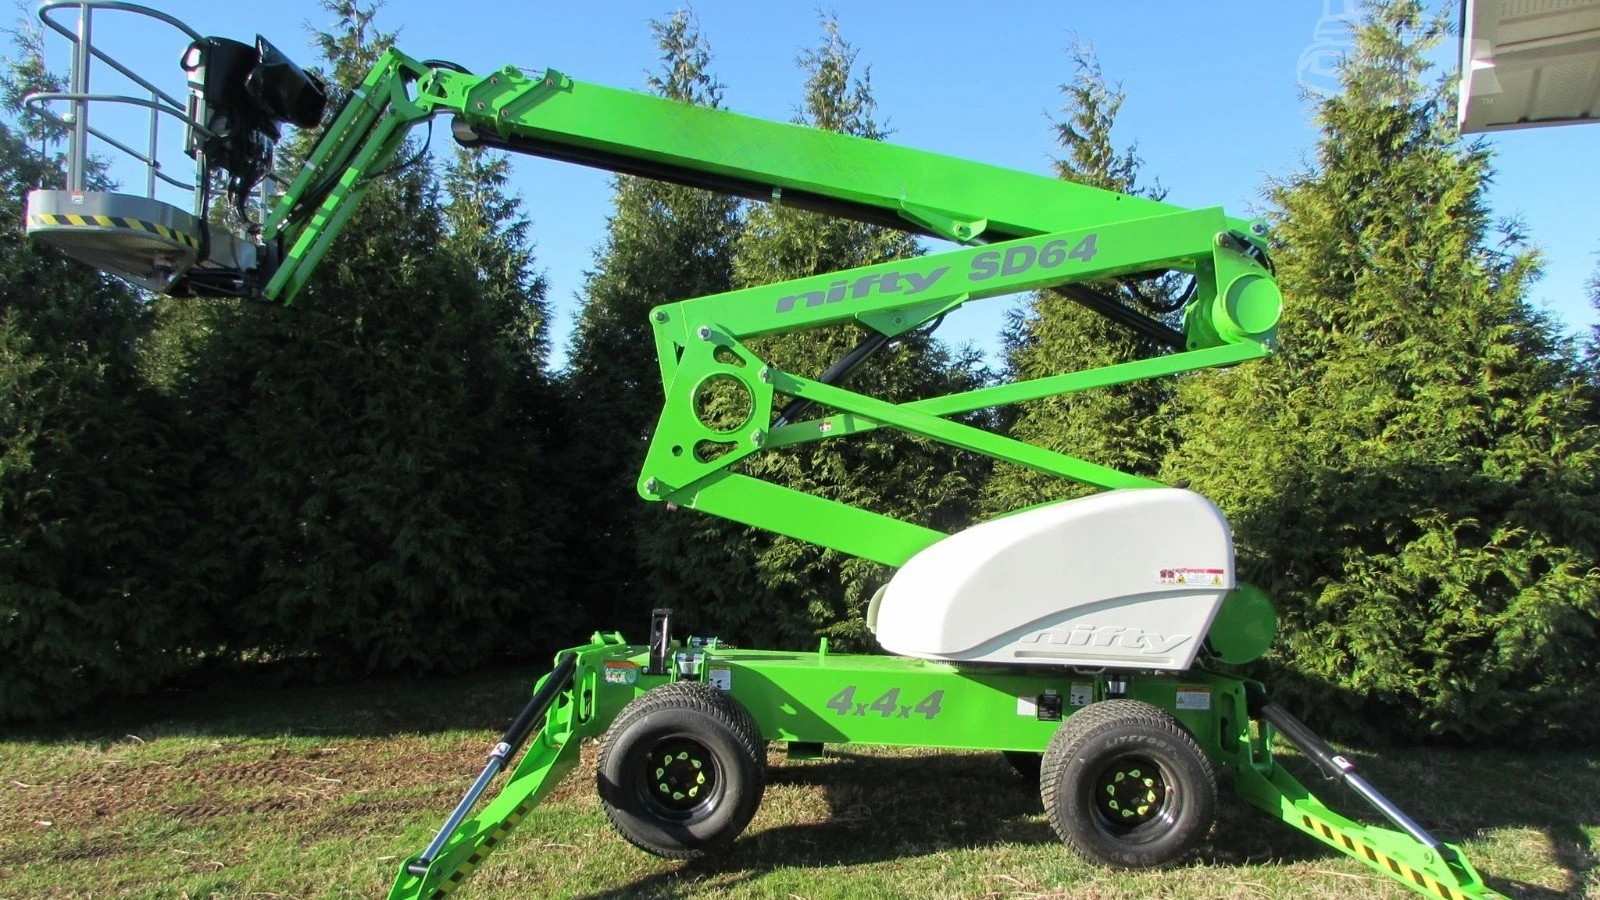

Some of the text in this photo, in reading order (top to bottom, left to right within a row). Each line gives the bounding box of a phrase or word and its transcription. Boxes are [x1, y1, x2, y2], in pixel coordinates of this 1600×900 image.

[775, 233, 1098, 314] nifty SD64
[1021, 624, 1192, 654] nifty
[826, 685, 945, 721] 4x4x4
